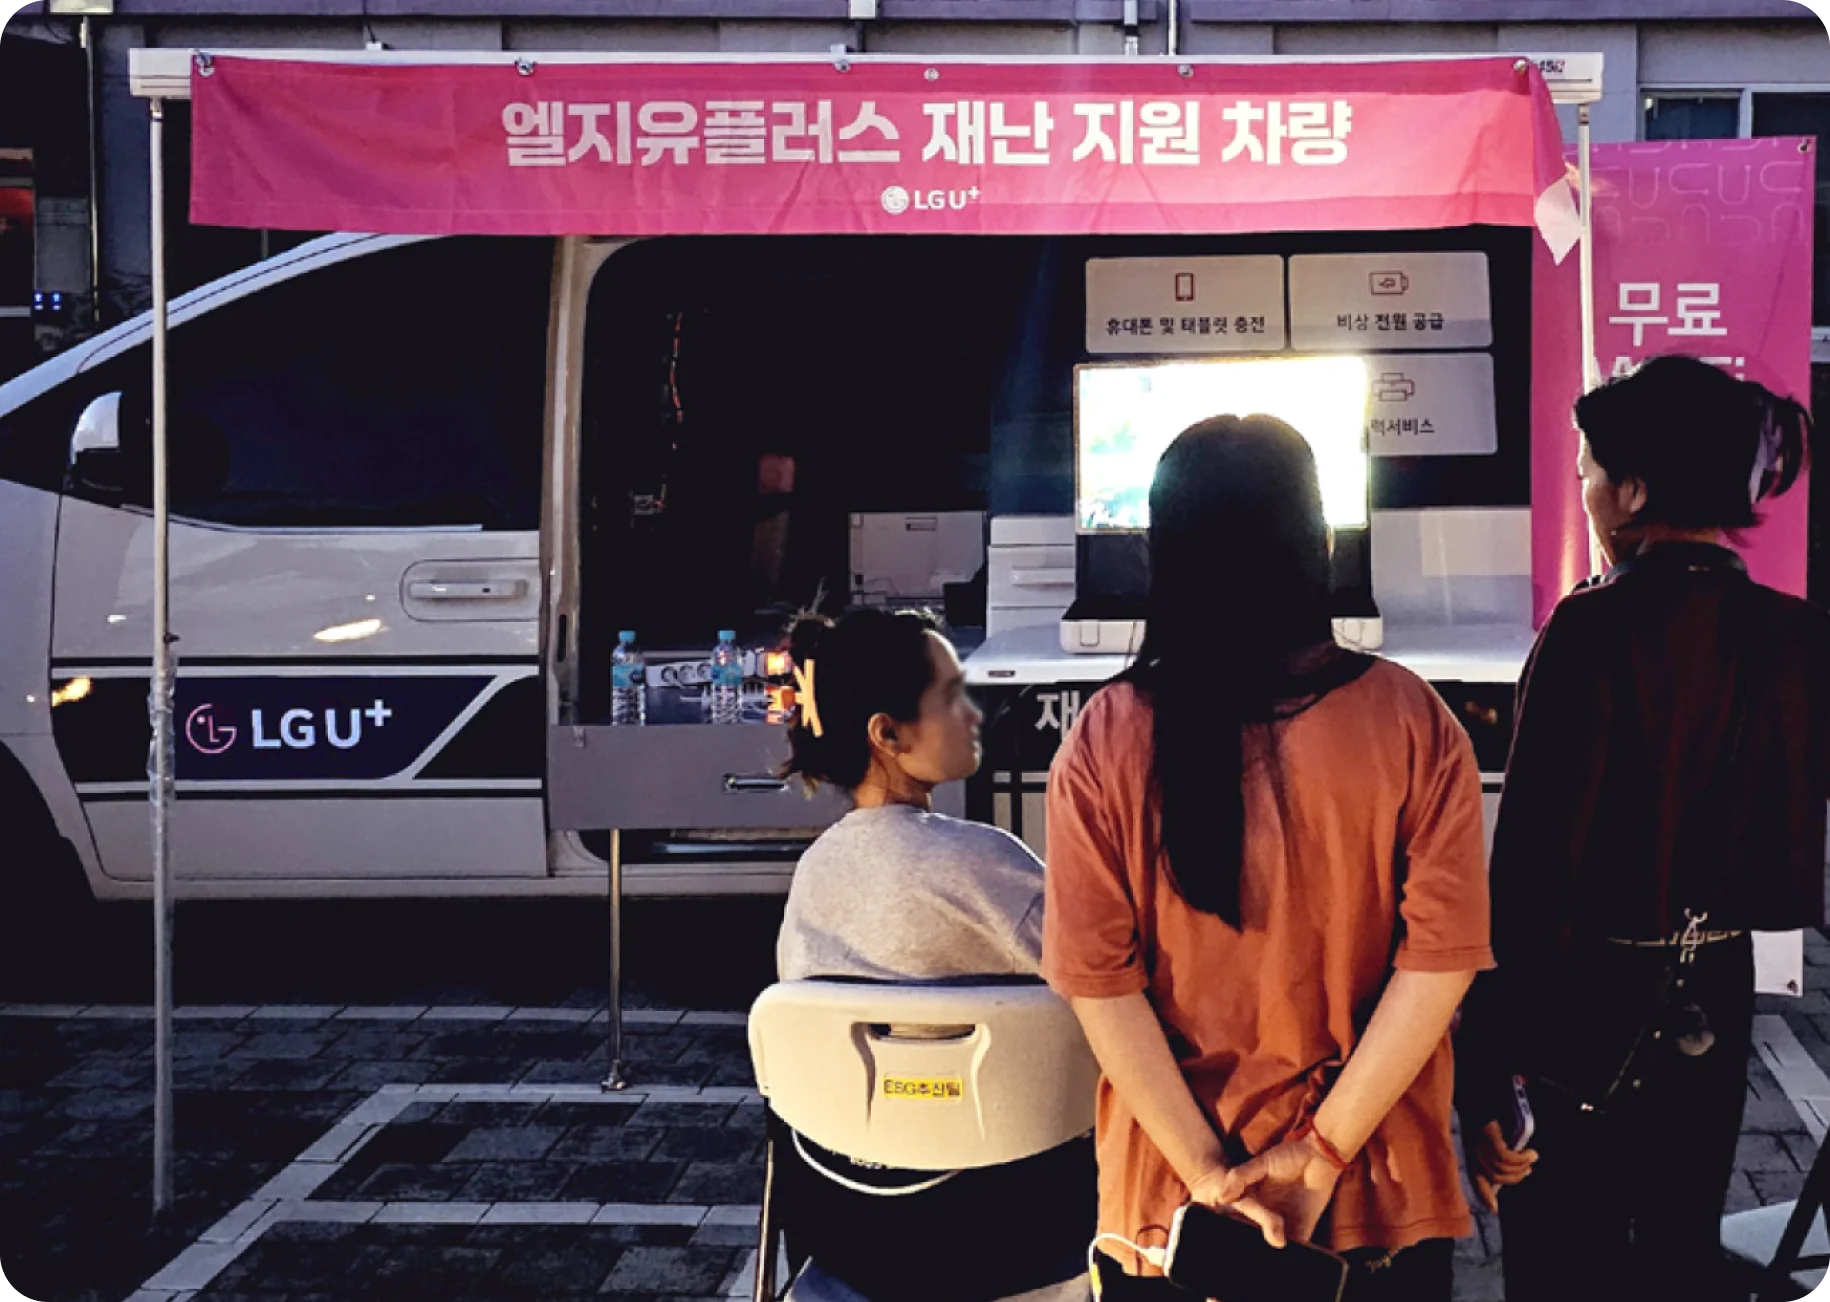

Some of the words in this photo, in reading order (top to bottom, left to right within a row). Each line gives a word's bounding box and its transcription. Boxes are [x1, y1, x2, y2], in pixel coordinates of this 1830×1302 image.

[502, 100, 900, 167] 엘지유플러스
[921, 100, 1054, 165] 재난
[1072, 100, 1201, 165] 지원
[1221, 100, 1352, 166] 차량
[1106, 317, 1153, 336] 휴대폰
[1159, 316, 1175, 335] 및
[1234, 315, 1265, 334] 충전
[1337, 313, 1369, 331] 비상
[1374, 312, 1408, 331] 전원
[1412, 312, 1445, 331] 공급
[1609, 282, 1728, 347] 무료
